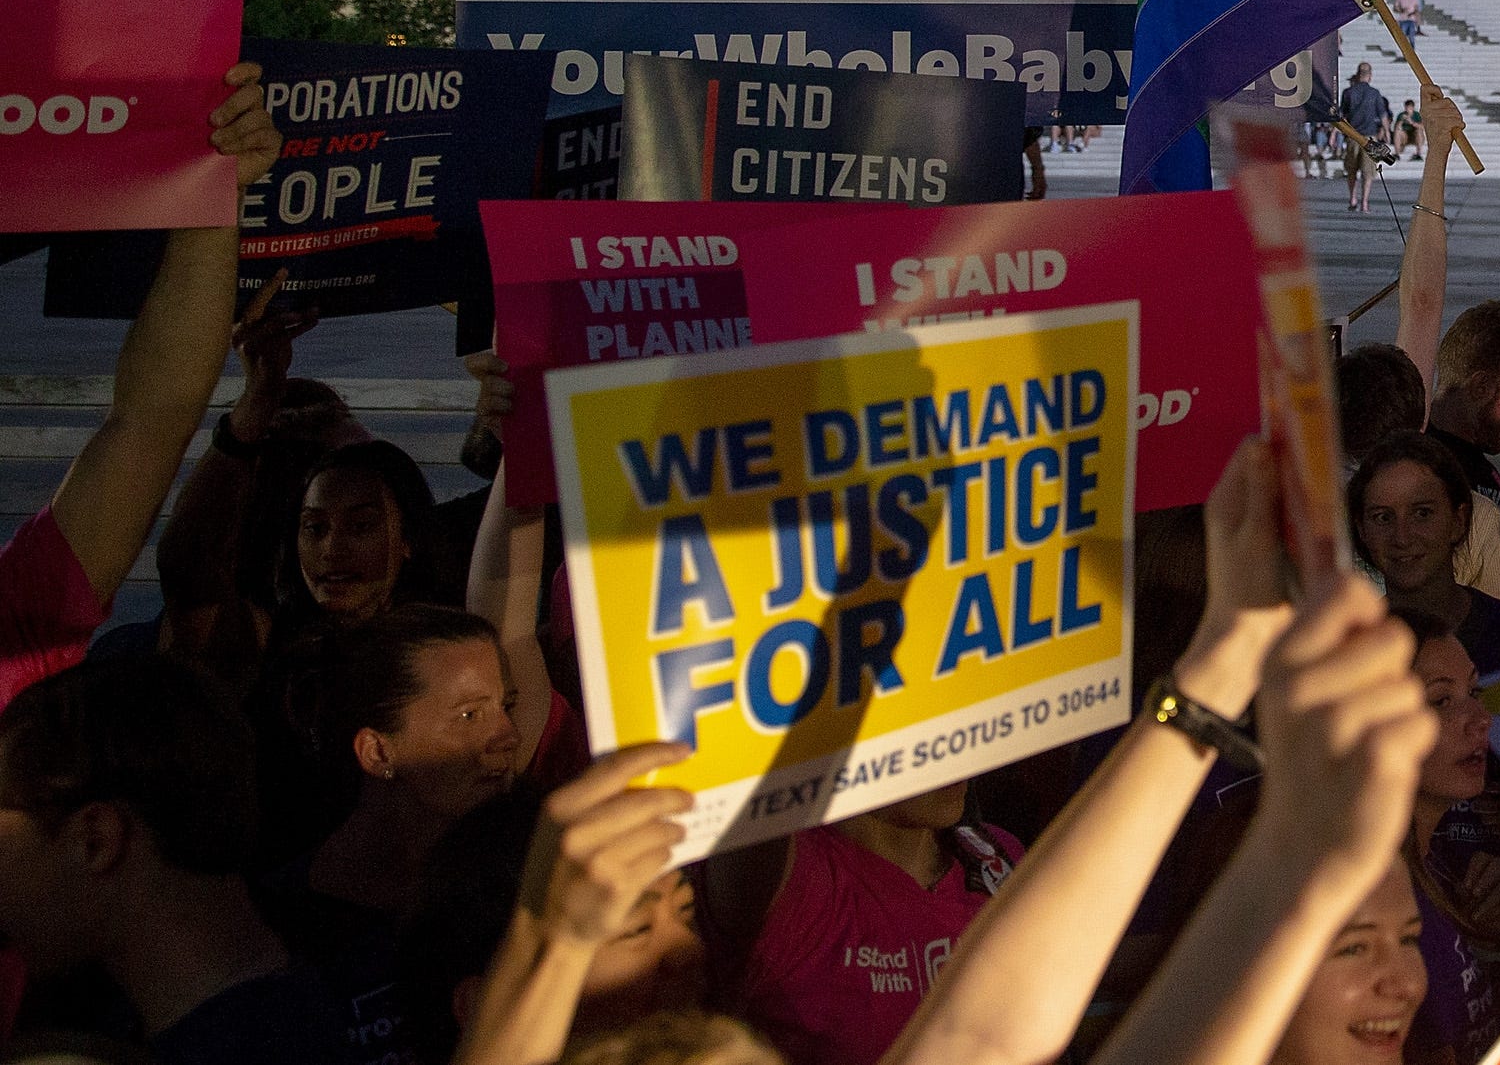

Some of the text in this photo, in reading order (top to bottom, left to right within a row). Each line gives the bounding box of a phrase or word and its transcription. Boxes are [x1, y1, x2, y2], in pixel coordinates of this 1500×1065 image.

[263, 71, 464, 123] PORATIONS
[736, 81, 833, 130] END
[280, 130, 386, 160] RE NOT
[240, 155, 443, 229] EOPLE
[731, 148, 948, 203] CITIZENS
[270, 232, 330, 254] CITIZENS
[334, 226, 379, 245] UNITED
[570, 235, 739, 269] I STAND
[582, 278, 701, 314] WITH
[857, 249, 1068, 306] I STAND
[587, 318, 752, 359] PLANNE
[622, 420, 782, 508] WE
[804, 368, 1108, 479] DEMAND
[653, 437, 1102, 634] A JUSTICE
[654, 547, 1104, 755] FOR ALL
[748, 776, 823, 823] TEXT
[832, 749, 905, 795] SAVE
[912, 713, 1015, 769] SCOTUS
[1019, 700, 1051, 730] TO
[1057, 678, 1122, 717] 30644
[844, 946, 852, 968] I
[870, 971, 913, 993] With
